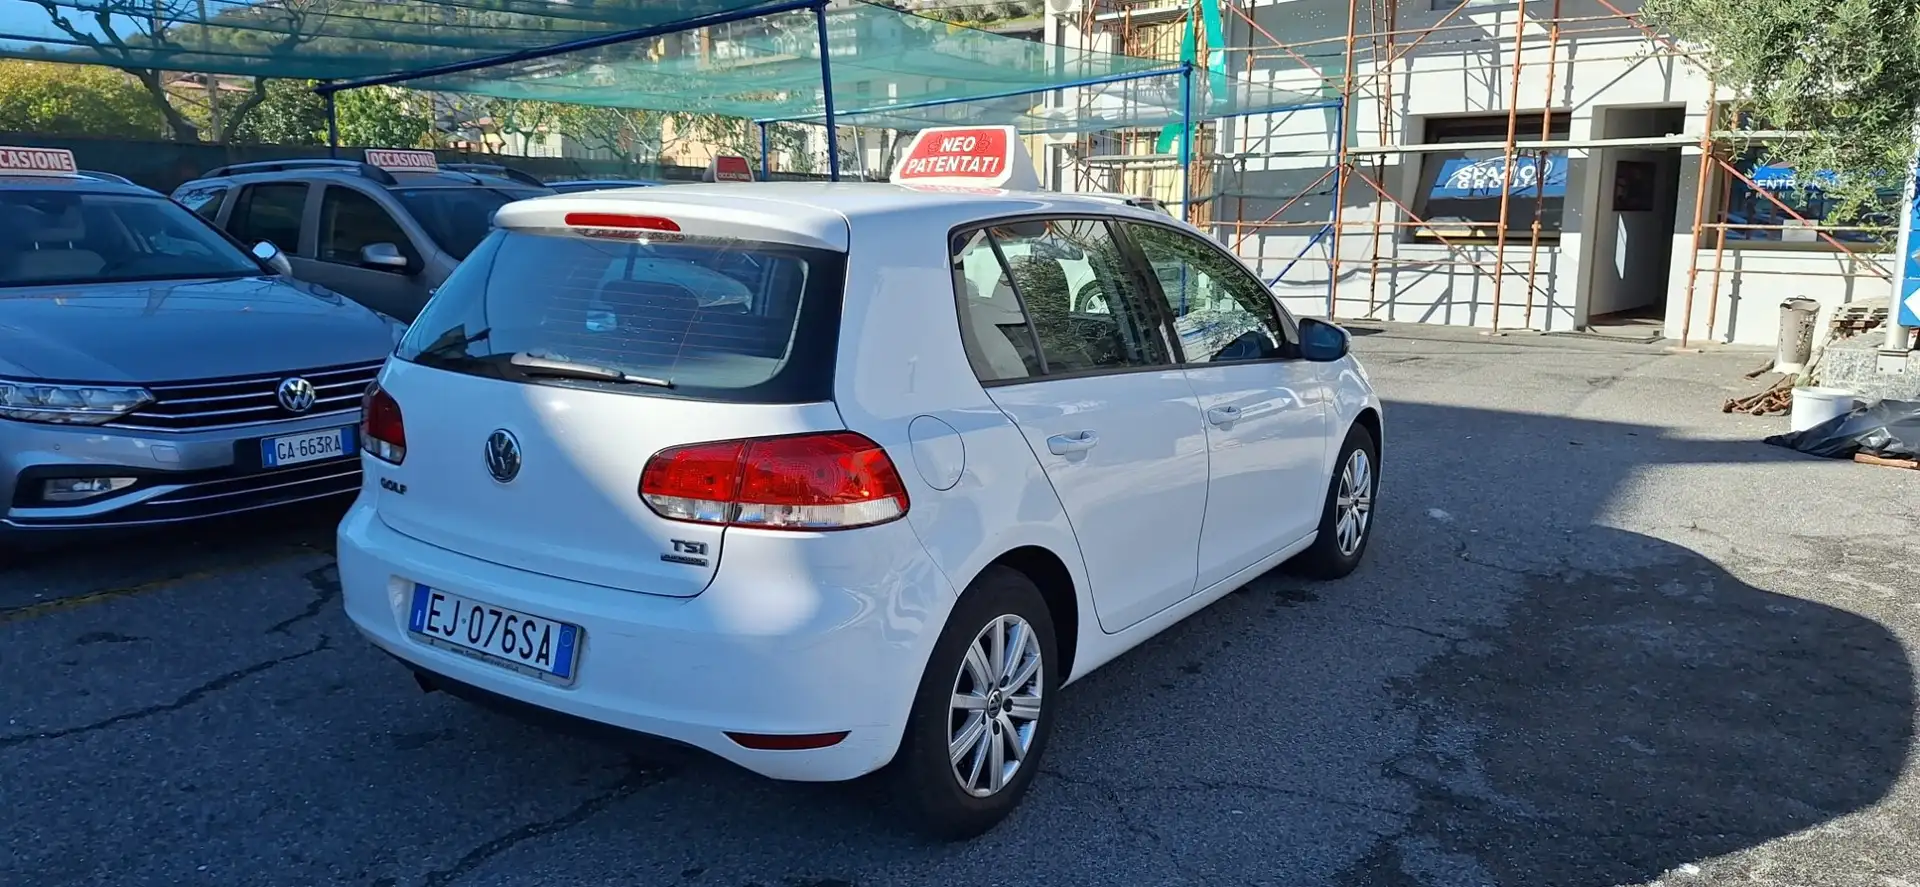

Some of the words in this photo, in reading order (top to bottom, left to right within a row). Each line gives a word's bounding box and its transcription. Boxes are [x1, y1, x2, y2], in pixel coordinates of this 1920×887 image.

[940, 136, 977, 152] NEO
[370, 152, 435, 168] OCCASIONE
[905, 156, 1000, 175] PATENTATI
[380, 477, 407, 495] GOLF
[670, 539, 709, 556] TSI
